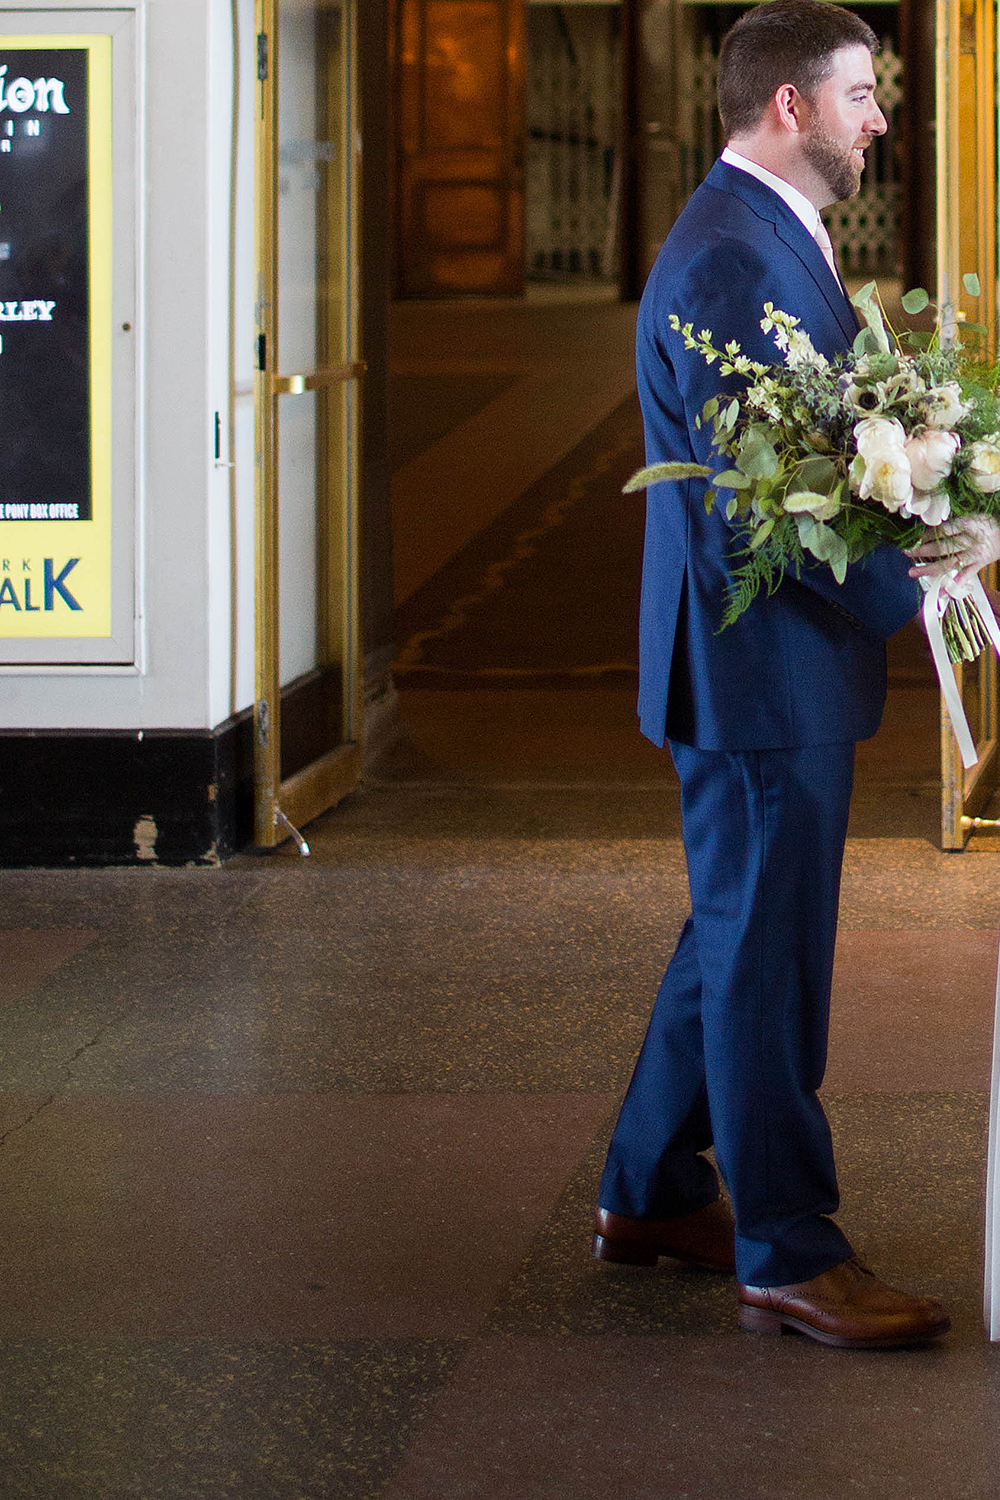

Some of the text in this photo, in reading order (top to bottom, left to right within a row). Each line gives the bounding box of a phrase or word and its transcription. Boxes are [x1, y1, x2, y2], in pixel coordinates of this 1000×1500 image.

[5, 503, 29, 518] PONY
[30, 503, 48, 518] BOX
[49, 503, 79, 518] OFFICE
